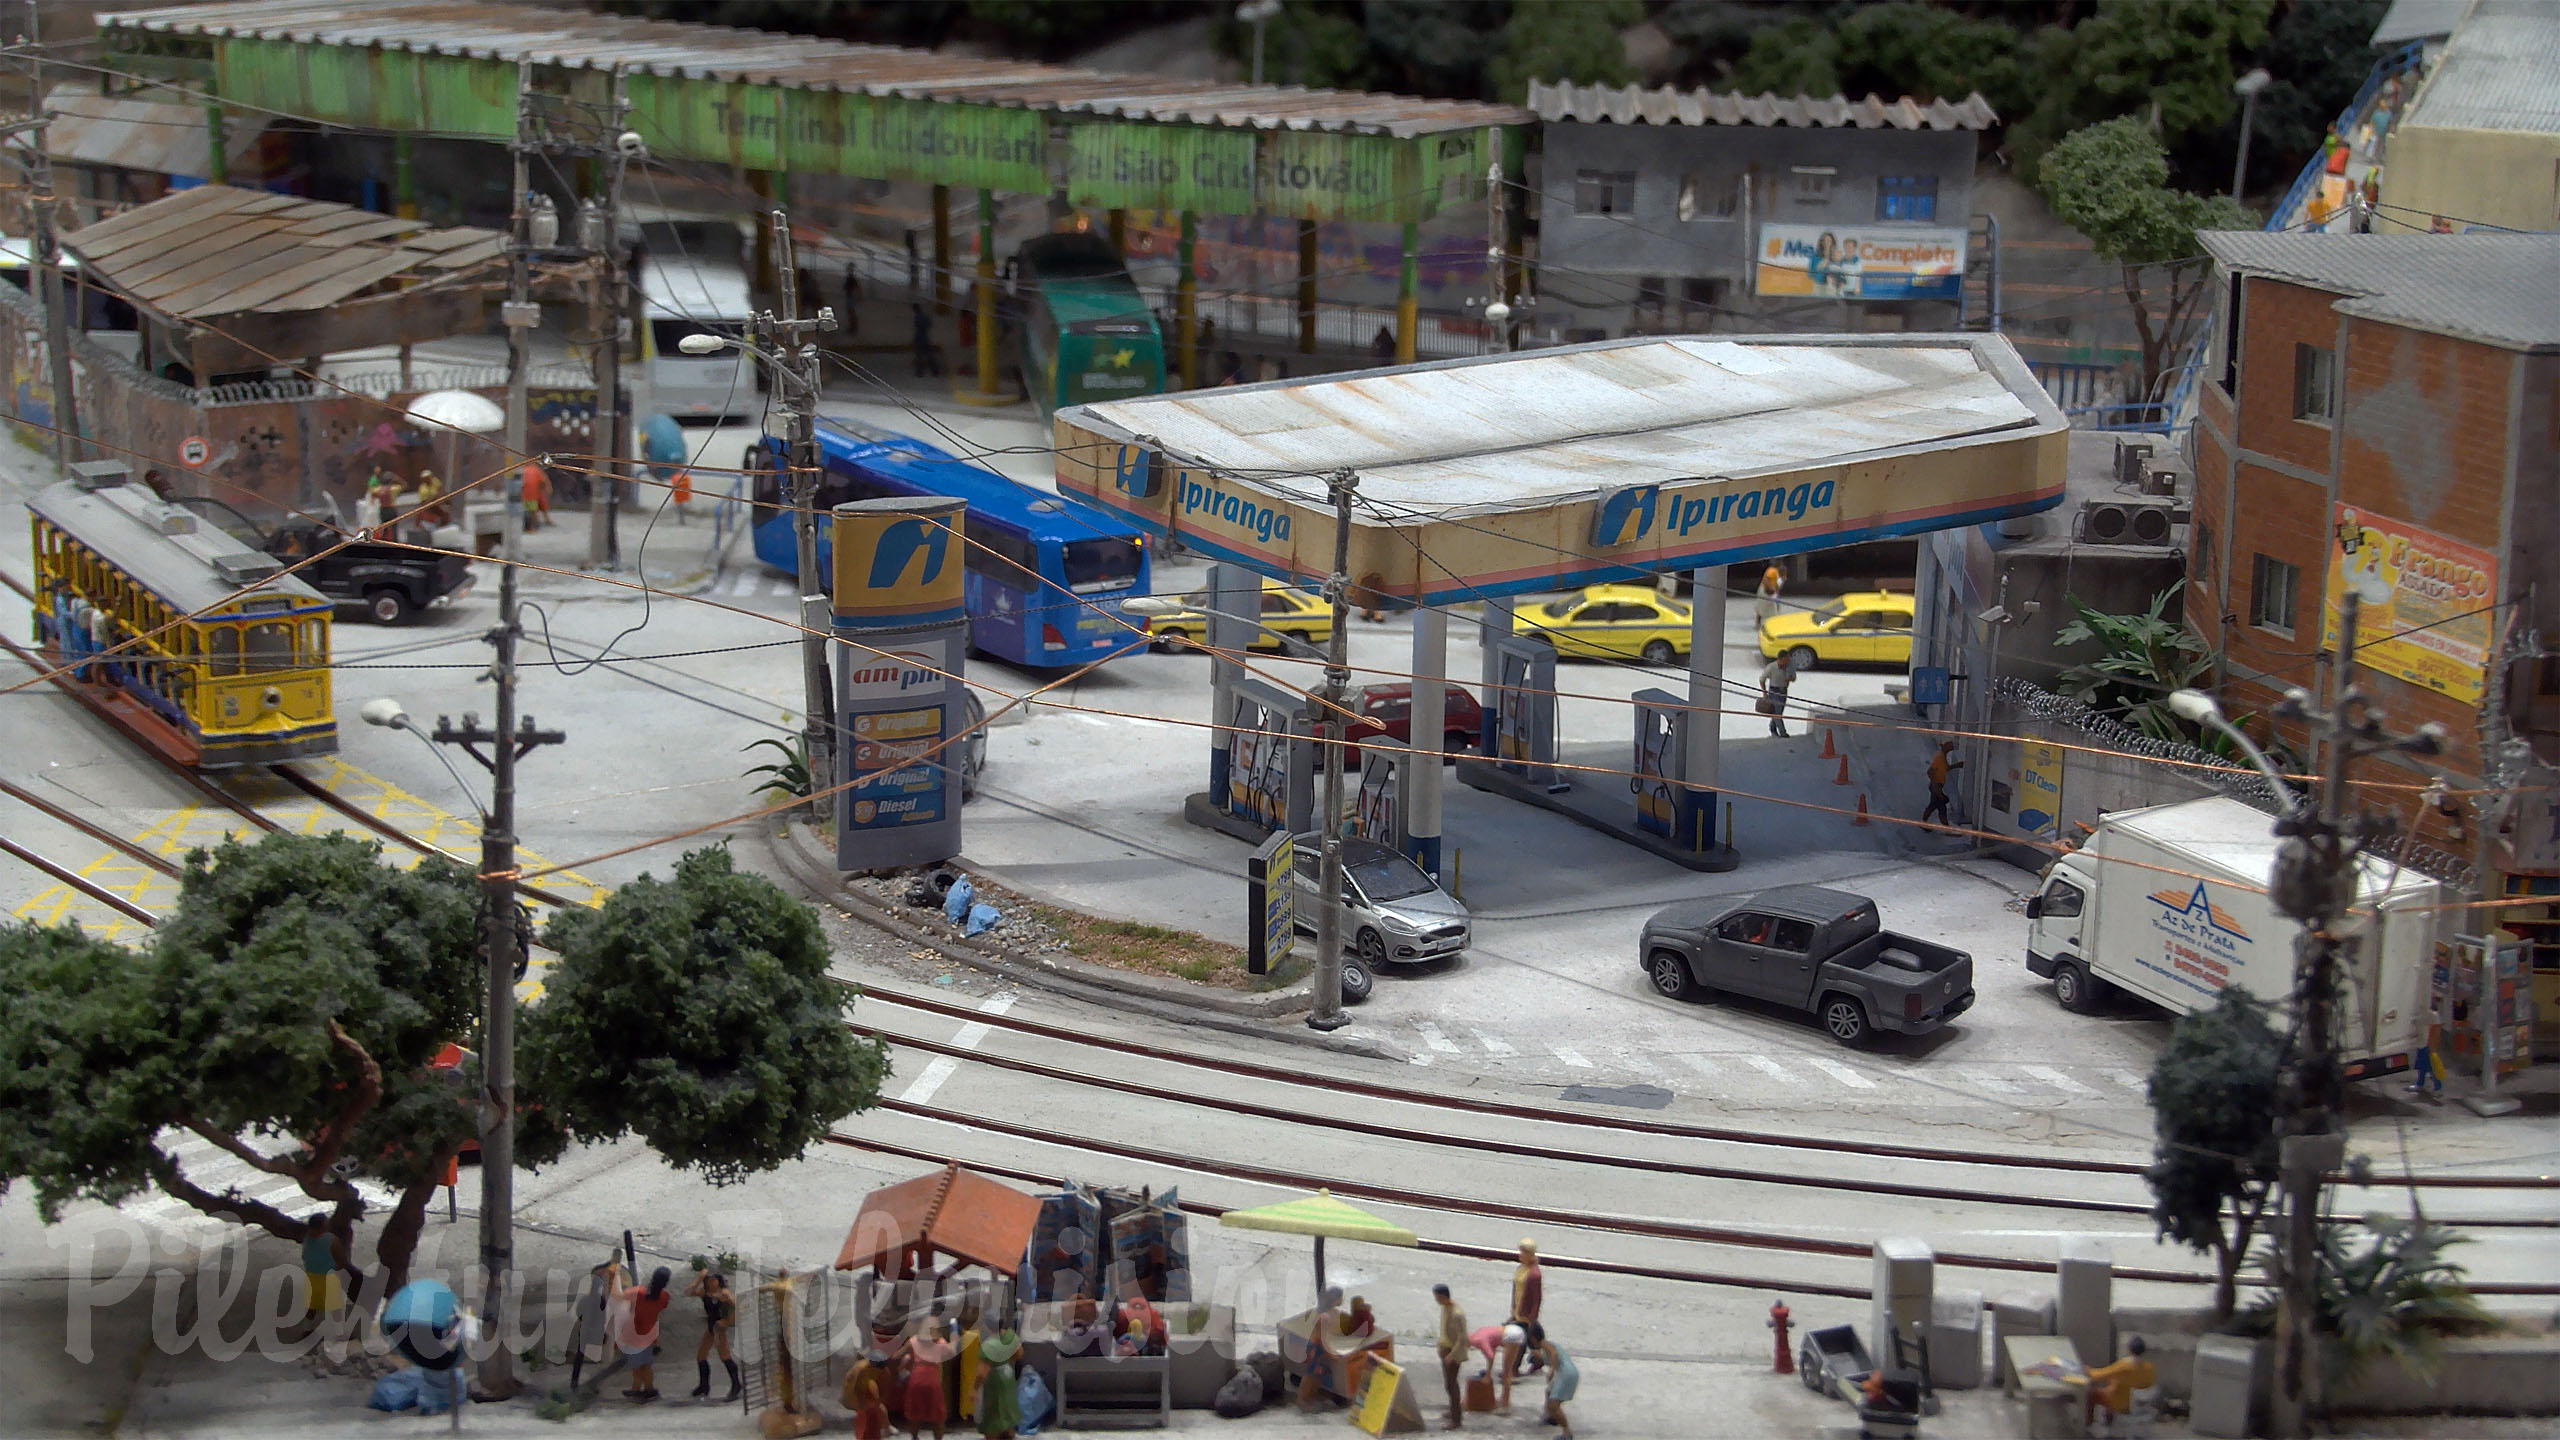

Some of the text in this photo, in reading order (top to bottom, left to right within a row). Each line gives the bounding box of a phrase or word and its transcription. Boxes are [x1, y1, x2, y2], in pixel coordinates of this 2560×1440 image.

[1177, 470, 1291, 543] Ipiranga
[1667, 479, 1836, 536] Ipiranga
[2388, 534, 2489, 598] Frango
[877, 712, 929, 732] Original
[878, 741, 930, 760] Original
[878, 767, 930, 787] Original
[2025, 769, 2058, 793] DT Clean
[878, 797, 918, 814] Diesel
[2199, 925, 2236, 951] Prata
